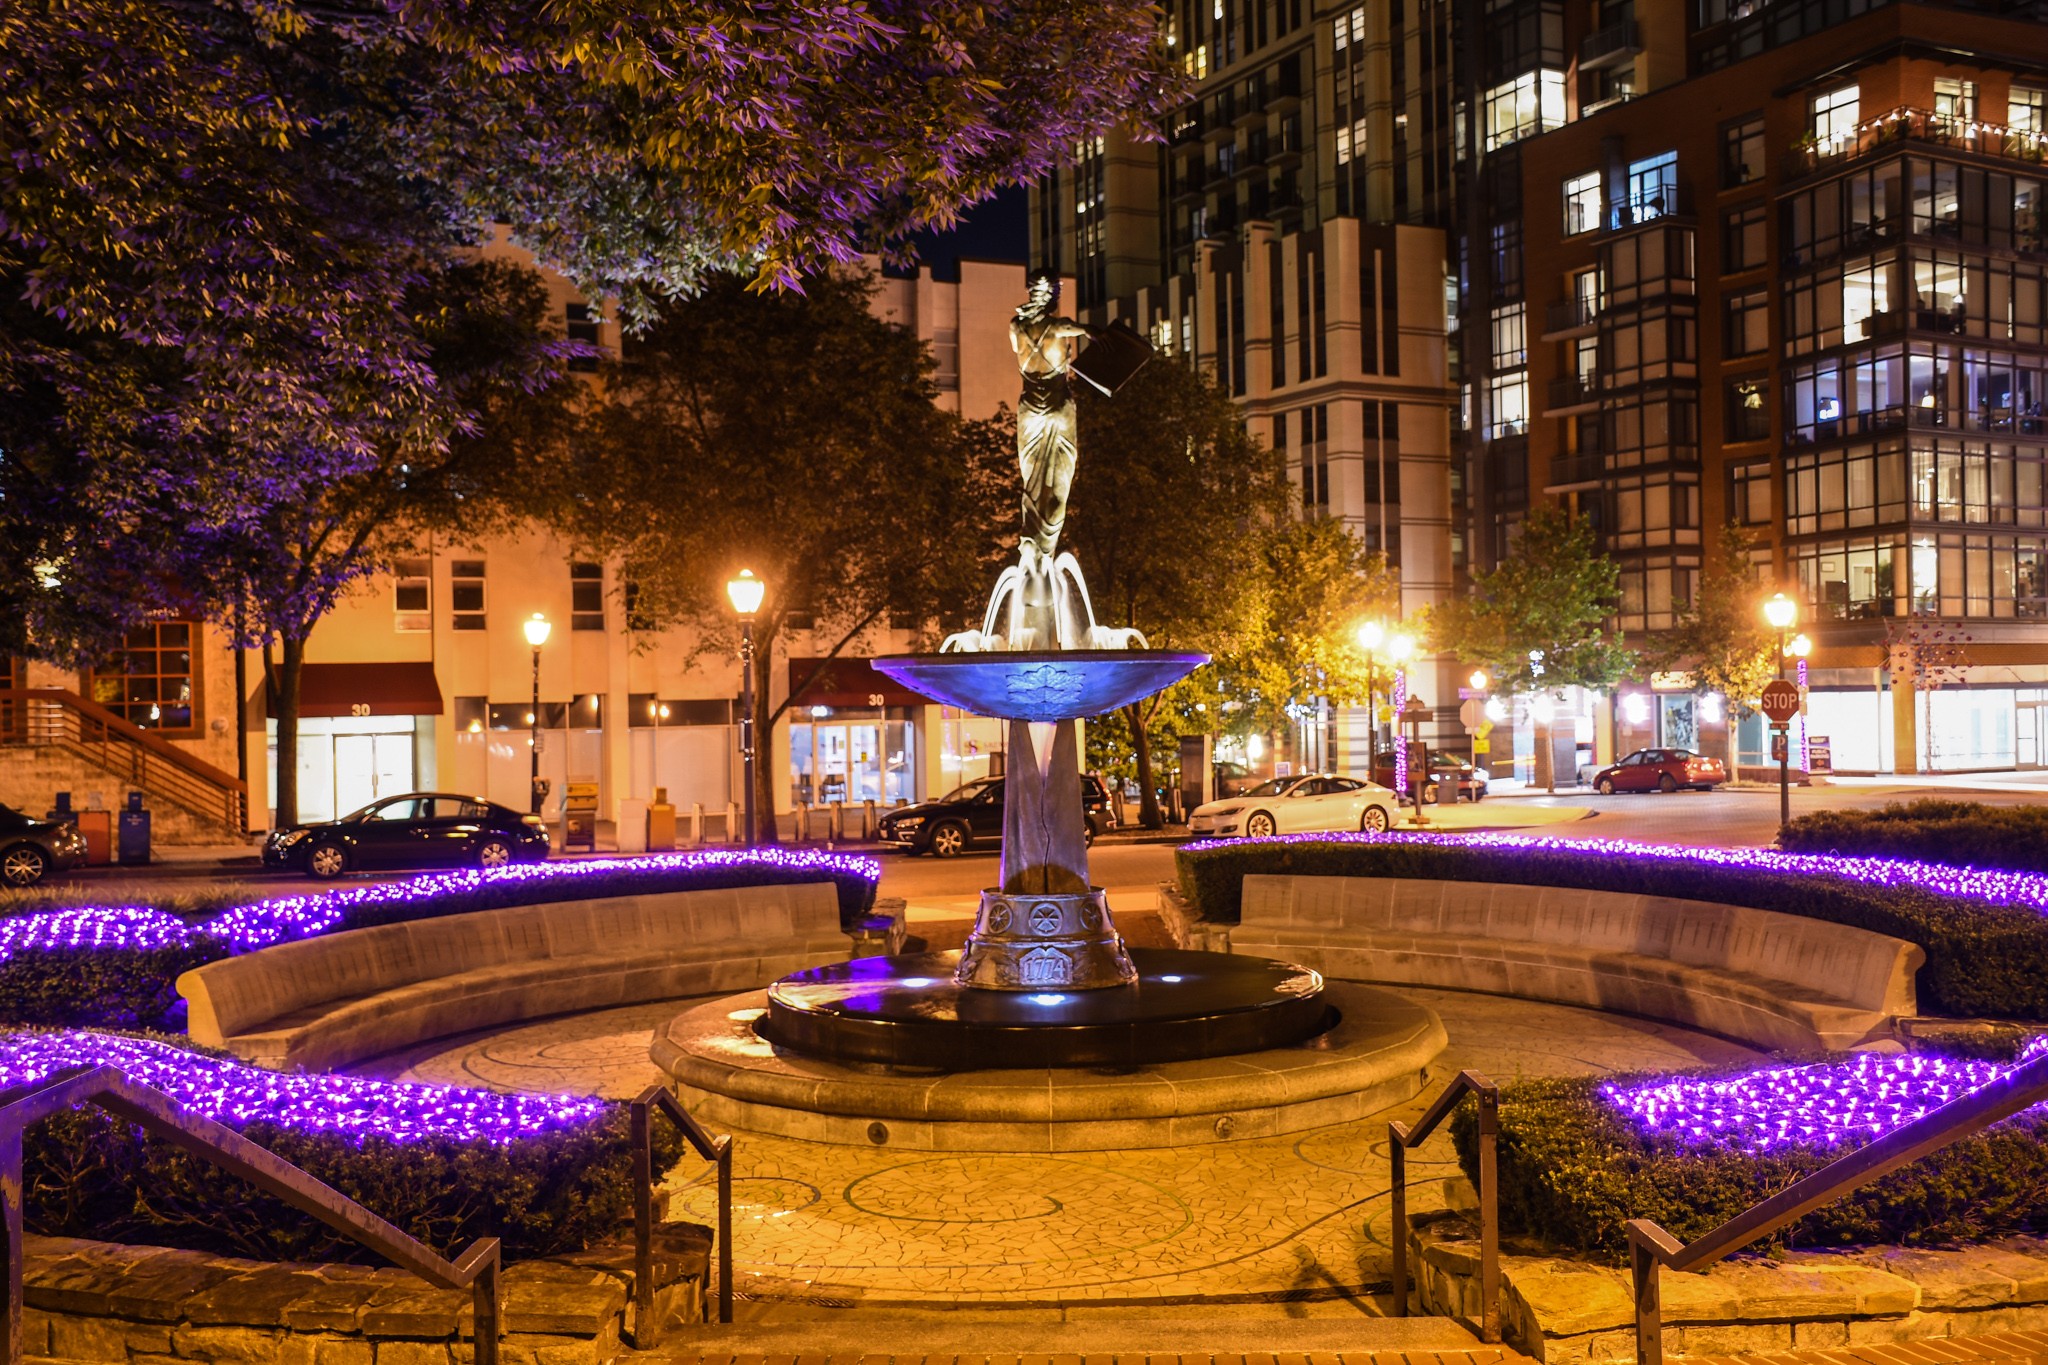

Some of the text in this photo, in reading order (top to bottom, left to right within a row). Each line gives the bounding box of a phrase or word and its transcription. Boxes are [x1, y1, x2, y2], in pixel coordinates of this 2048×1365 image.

[869, 694, 884, 706] 30
[1763, 693, 1797, 709] STOP
[352, 704, 371, 716] 30
[1776, 736, 1786, 750] P
[1024, 956, 1066, 978] 1774
